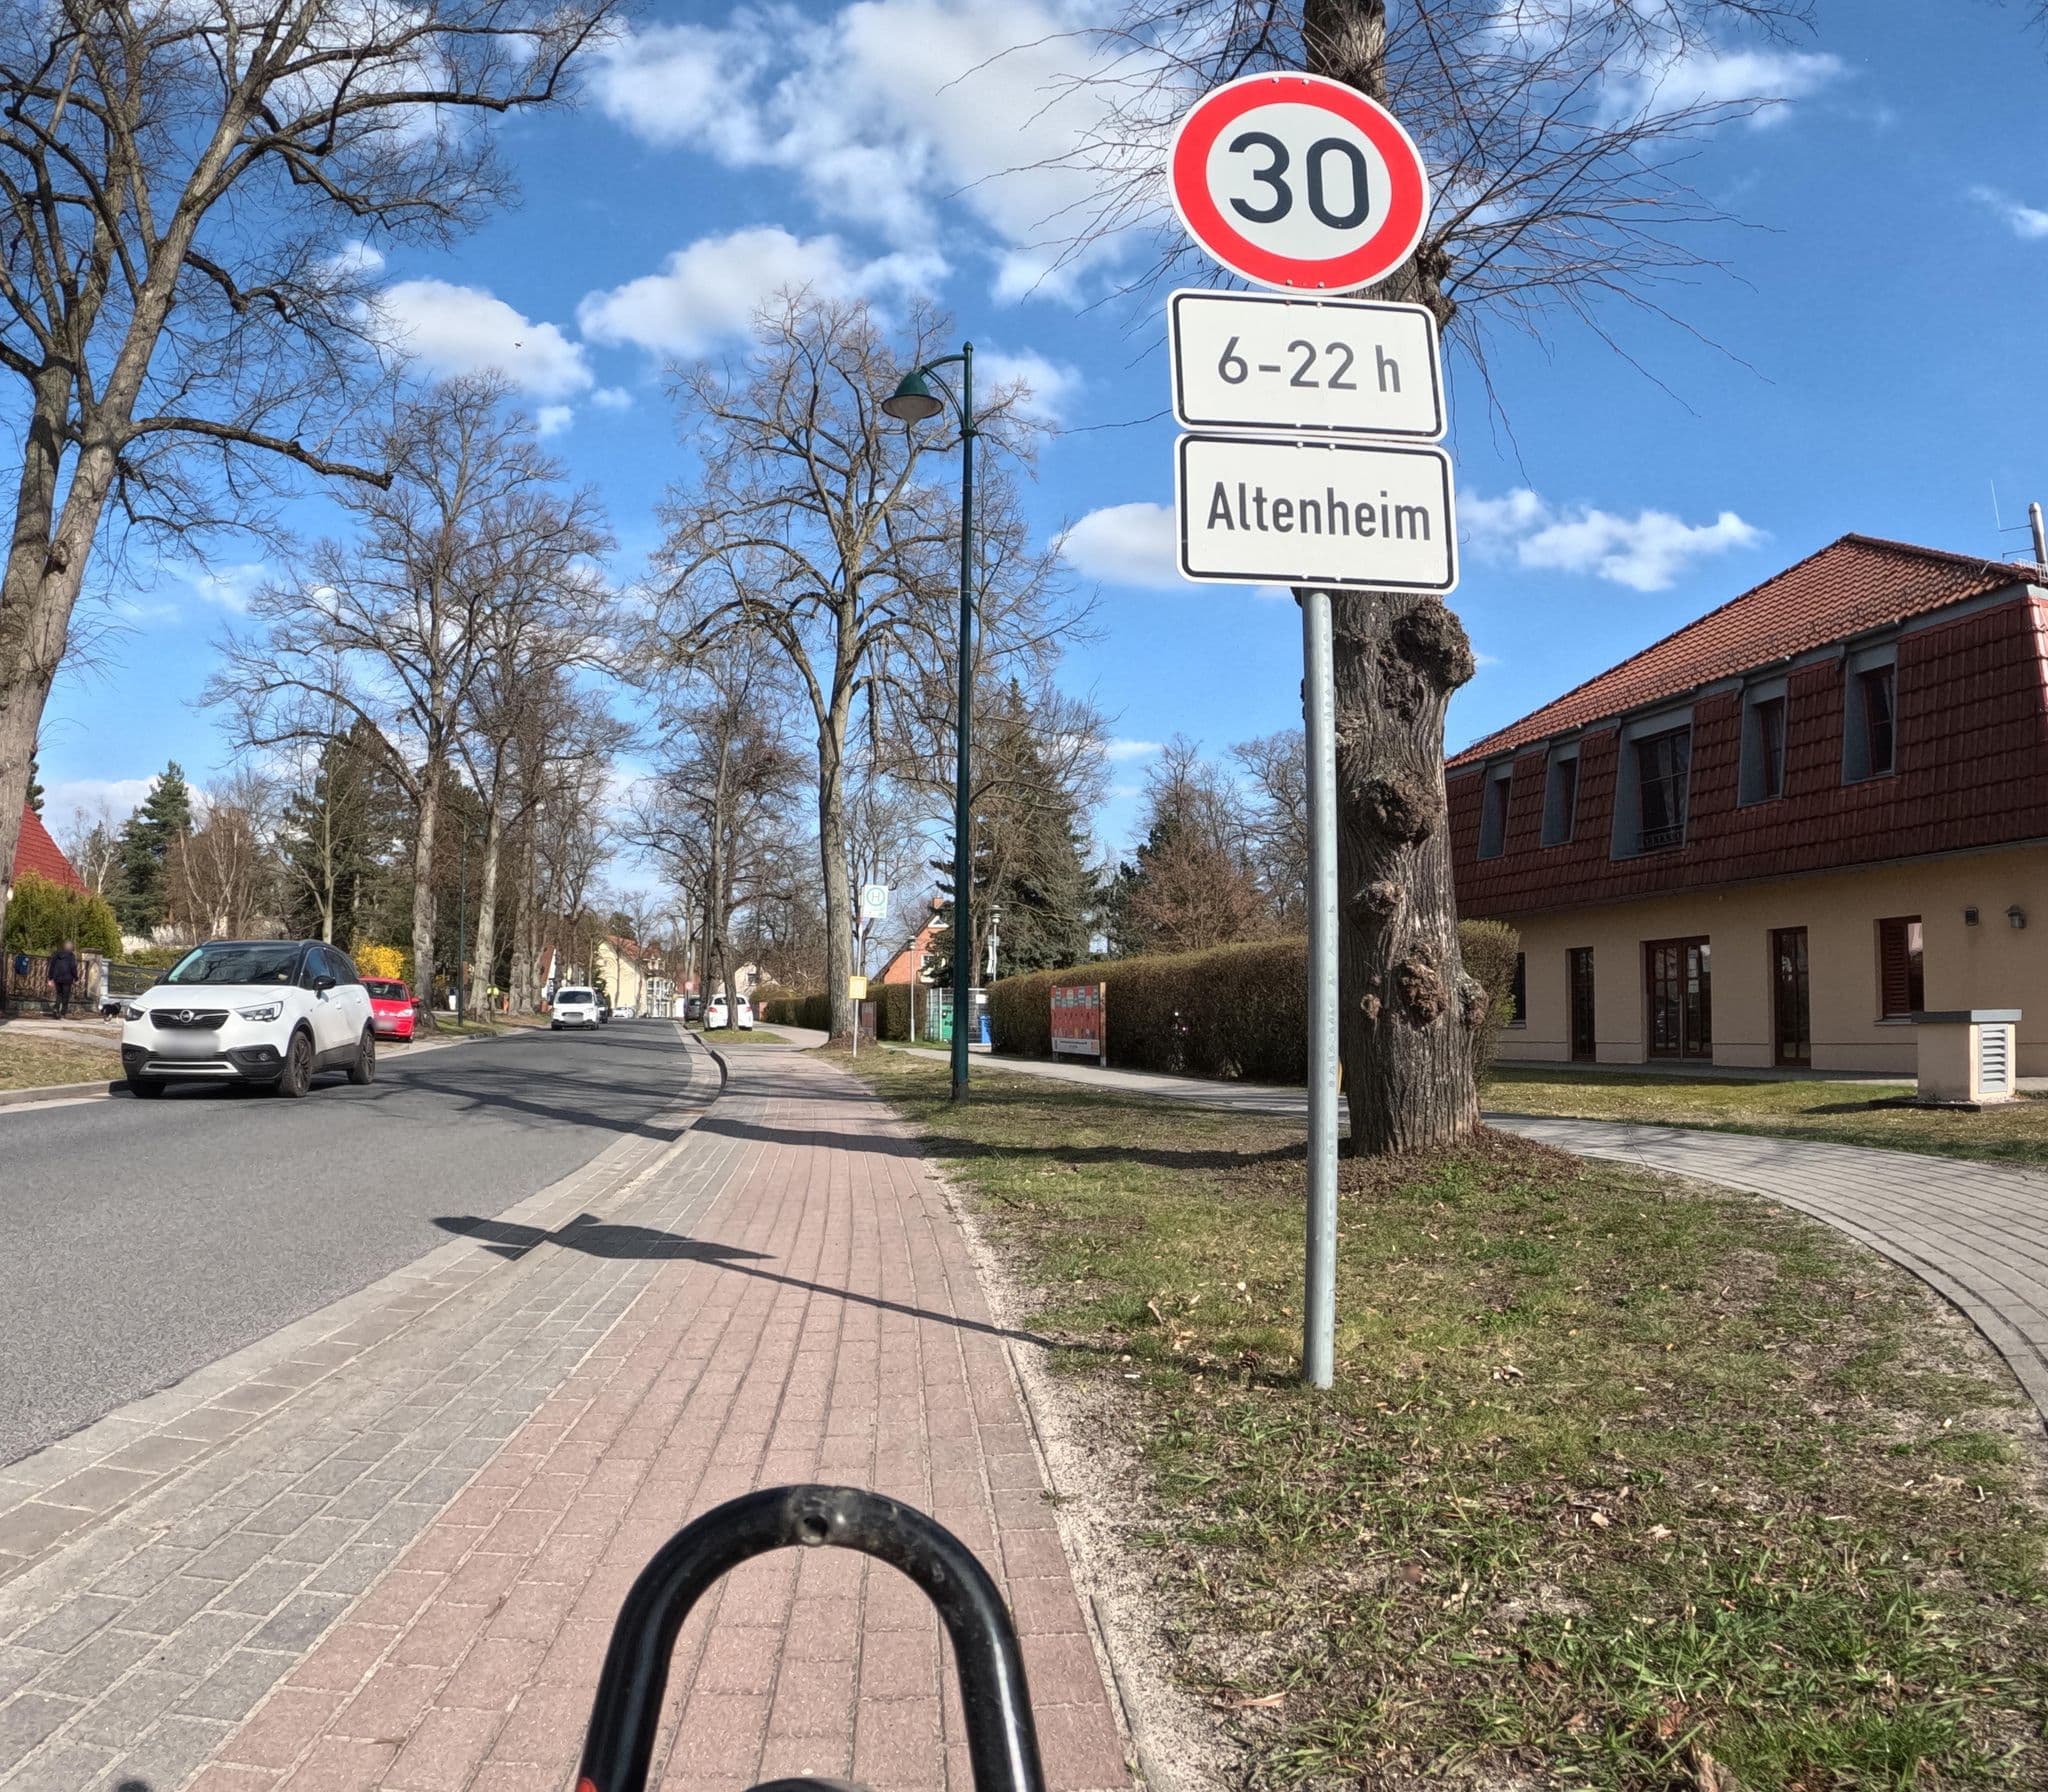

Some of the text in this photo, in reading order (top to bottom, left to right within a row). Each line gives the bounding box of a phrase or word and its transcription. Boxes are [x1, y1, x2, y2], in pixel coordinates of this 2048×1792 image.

[1229, 132, 1370, 229] 30
[1218, 336, 1401, 393] 6-22 h
[1207, 481, 1431, 541] Altenheim
